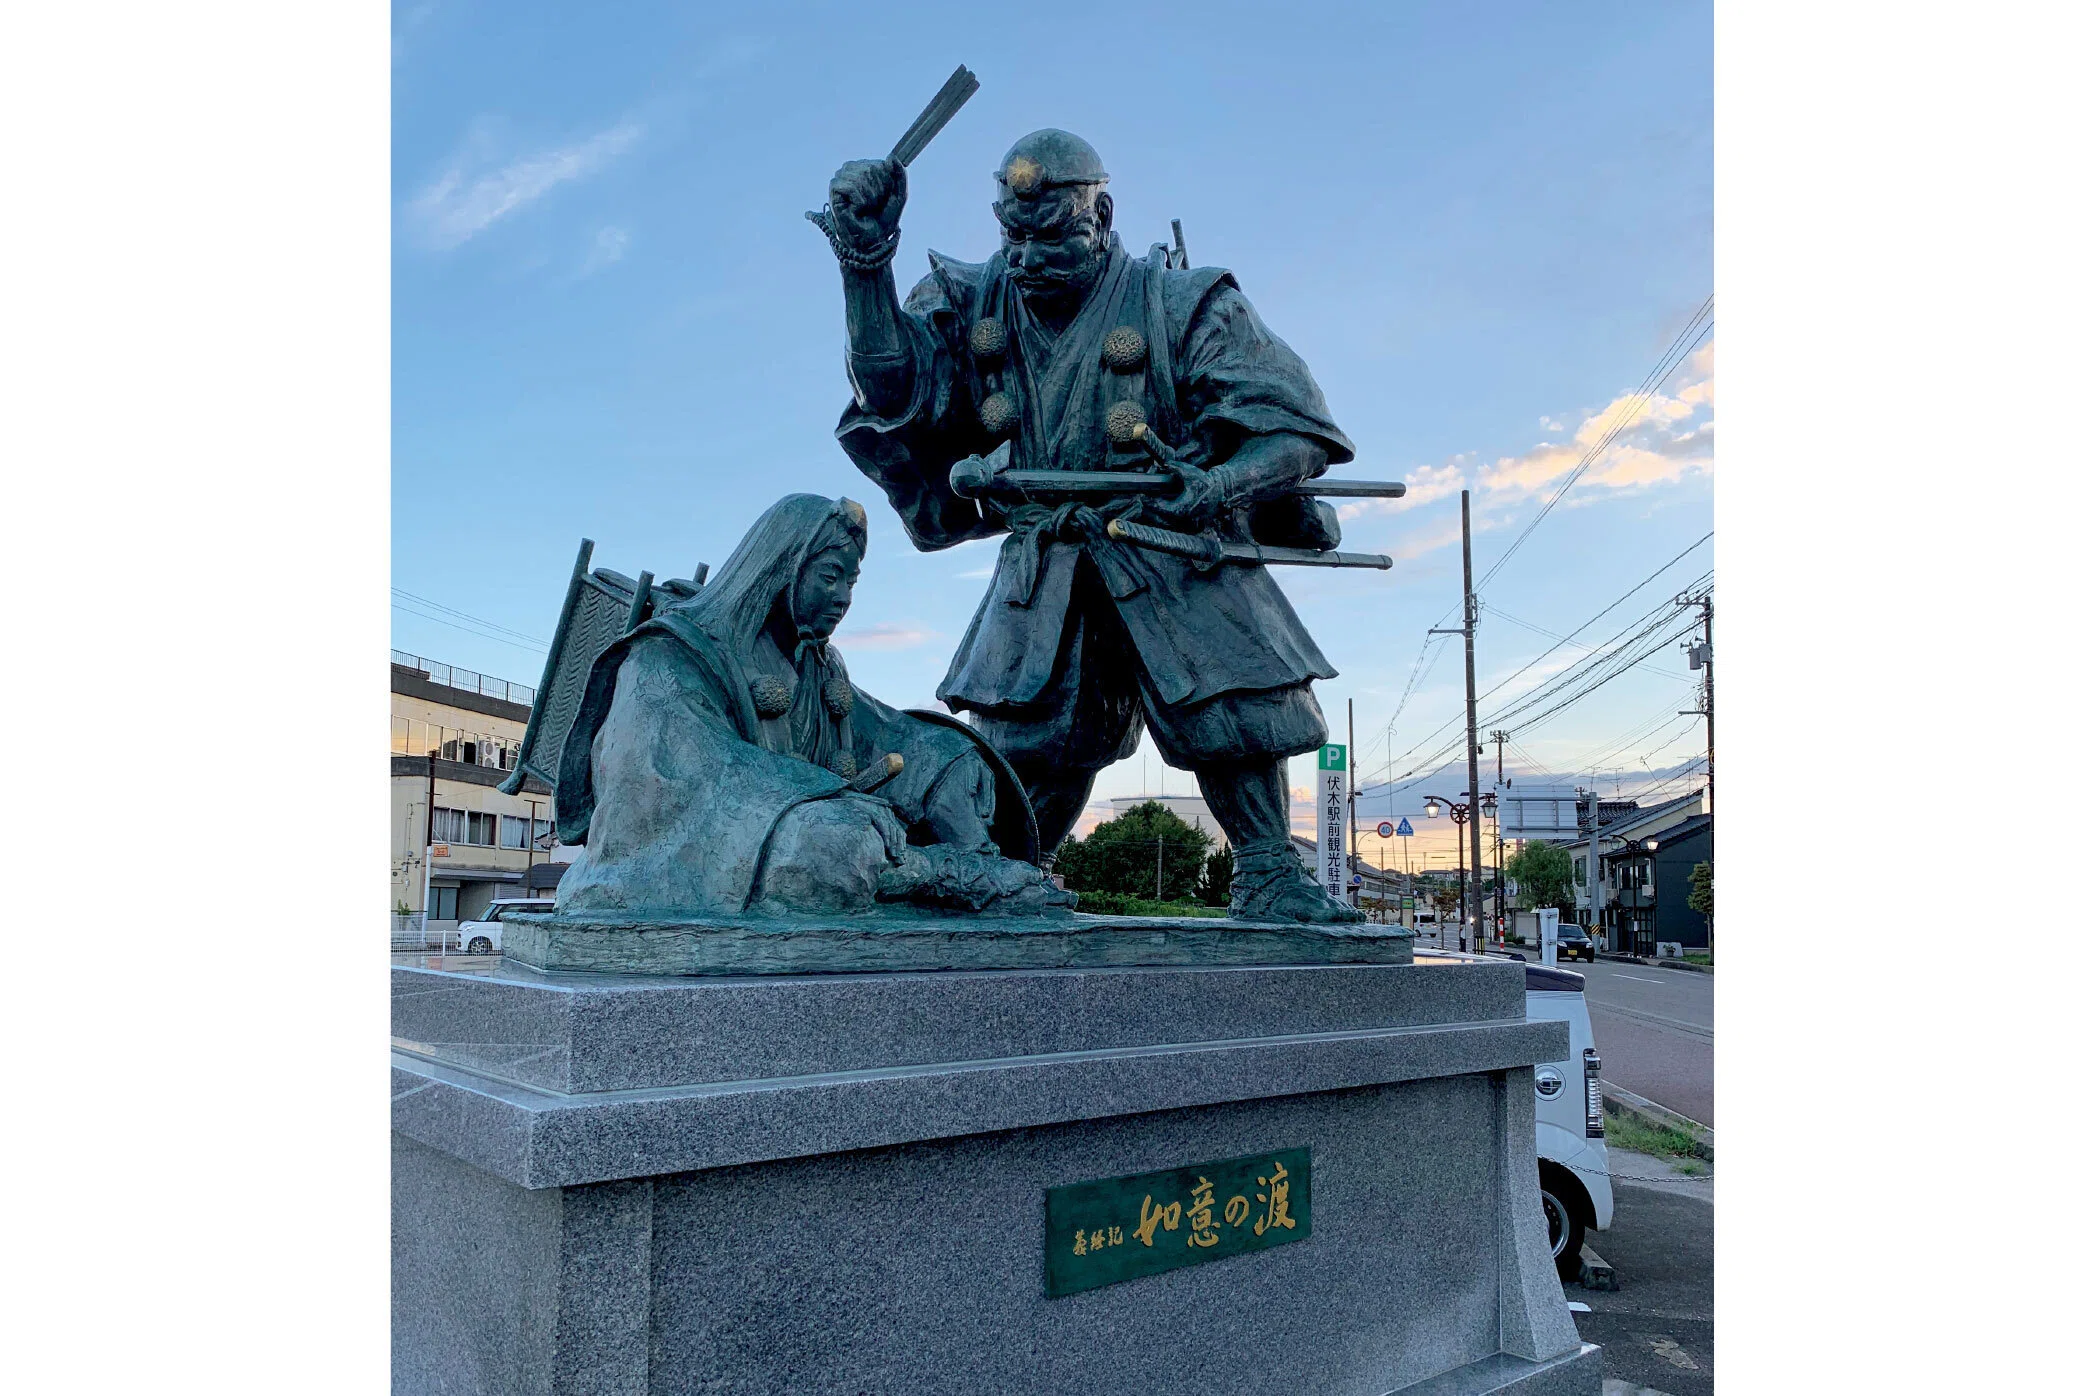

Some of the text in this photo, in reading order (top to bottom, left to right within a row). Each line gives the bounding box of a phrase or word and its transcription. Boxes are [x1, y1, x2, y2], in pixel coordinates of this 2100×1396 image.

[1326, 746, 1341, 768] P
[1327, 776, 1341, 896] 伏木駅前観光駐車
[1132, 1161, 1296, 1248] 如意の渡
